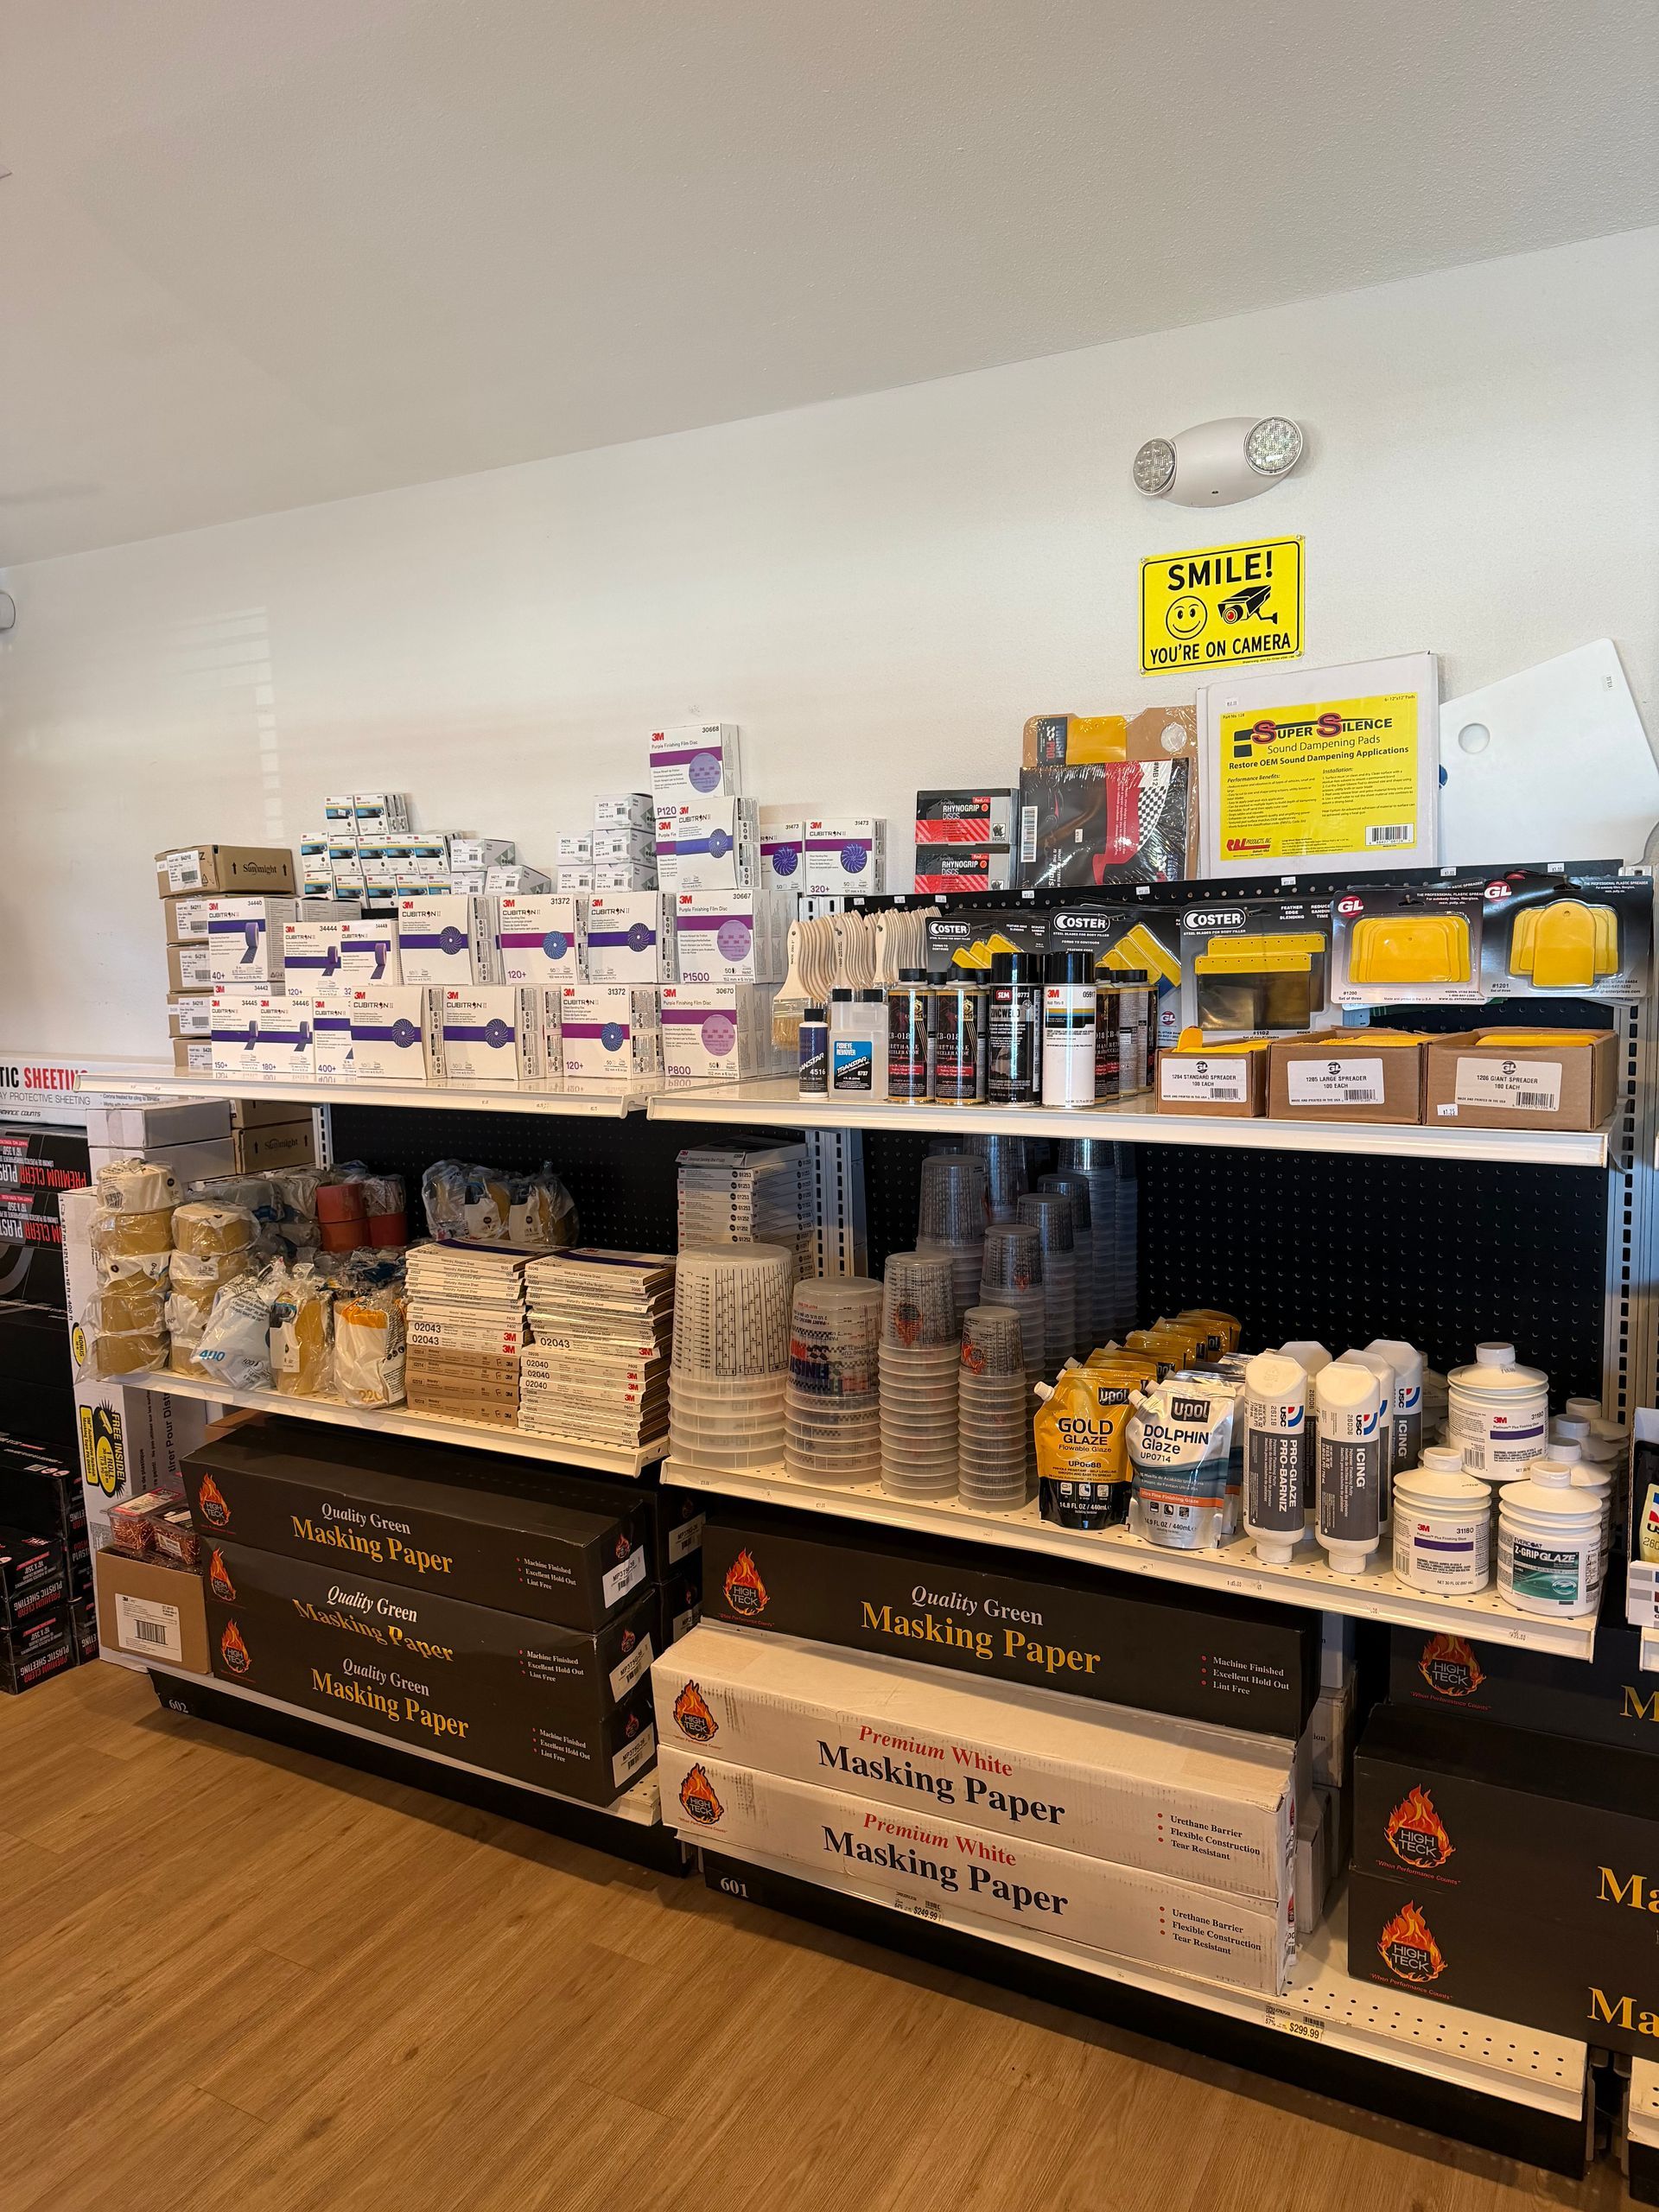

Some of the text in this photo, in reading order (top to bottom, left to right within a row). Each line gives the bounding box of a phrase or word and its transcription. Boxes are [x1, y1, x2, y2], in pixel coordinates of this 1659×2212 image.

[1168, 550, 1273, 591] SMILE!
[1150, 632, 1291, 665] YOU'RE ON CAMERA
[652, 733, 664, 741] 3M
[1267, 734, 1381, 753] Sound Dampening Pads
[1229, 746, 1409, 770] Restore OEM Sound Dampening Applications
[942, 812, 961, 821] DISCS
[943, 804, 980, 812] RHYNOGRIP
[810, 821, 823, 830] 3M
[941, 868, 959, 876] DISCS
[942, 861, 978, 869] RHYNOGRIP
[810, 885, 830, 893] 320+
[679, 895, 693, 904] 3M
[1338, 899, 1364, 913] GL
[1186, 912, 1241, 928] COSTER
[212, 971, 225, 980] 40+
[508, 970, 527, 980] 120+
[683, 972, 710, 982] P1500
[216, 985, 225, 994] 3M
[563, 988, 575, 997] 3M
[663, 988, 677, 997] 3M
[566, 1061, 584, 1070] 120+
[668, 1066, 691, 1075] P800
[10, 1092, 91, 1105] PROTECTIVE SHEETING
[414, 1323, 517, 1343] 02043 3M
[412, 1334, 516, 1355] 02043 3M
[199, 1350, 226, 1362] 400
[526, 1360, 638, 1381] 02040 3M
[525, 1381, 548, 1389] 02040
[1173, 1402, 1209, 1421] upol
[1531, 1411, 1544, 1421] 31180
[1058, 1417, 1113, 1435] GOLD
[1143, 1424, 1209, 1445] DOLPHIN
[112, 1414, 124, 1482] FREE INSIDE!
[1063, 1434, 1108, 1446] GLAZE
[1142, 1438, 1180, 1455] Glaze
[1398, 1419, 1408, 1458] ICING
[1141, 1452, 1172, 1463] UP0714
[1279, 1440, 1288, 1513] PRO-BARNIZ
[1289, 1440, 1298, 1509] PRO-GLAZE
[1356, 1447, 1366, 1488] ICING
[321, 1502, 412, 1535] Quality Green
[1417, 1524, 1430, 1533] 3M
[290, 1516, 454, 1574] Masking Paper
[1515, 1544, 1576, 1563] Z-GRIP GLAZE
[911, 1585, 1044, 1626] Quality Green
[861, 1600, 1101, 1675] Masking Paper
[526, 1650, 579, 1666] Machine Finished
[1213, 1656, 1285, 1678] Machine Finished
[342, 1657, 430, 1697] Quality Green
[1213, 1668, 1290, 1691] Excellent Hold Out
[1213, 1681, 1251, 1695] Lint Free
[168, 1699, 189, 1714] 602
[310, 1668, 470, 1738] Masking Paper
[859, 1725, 1014, 1777] Premium White
[1170, 1815, 1243, 1839] Urethane Barrier
[863, 1812, 1018, 1866] Premium White
[1170, 1827, 1262, 1856] Flexible Construction
[1400, 1830, 1435, 1847] HIGH
[1170, 1839, 1230, 1861] Tear Resistant
[1398, 1839, 1438, 1859] TECK
[1376, 1859, 1462, 1885] "When Performance Counts"
[720, 1877, 750, 1898] 601
[1172, 1909, 1244, 1934] Urethane Barrier
[1172, 1920, 1262, 1951] Flexible Construction
[1172, 1932, 1232, 1955] Tear Resistant
[1393, 1944, 1427, 1961] HIGH
[1391, 1953, 1429, 1973] TECK
[1289, 2022, 1319, 2039] $299.99
